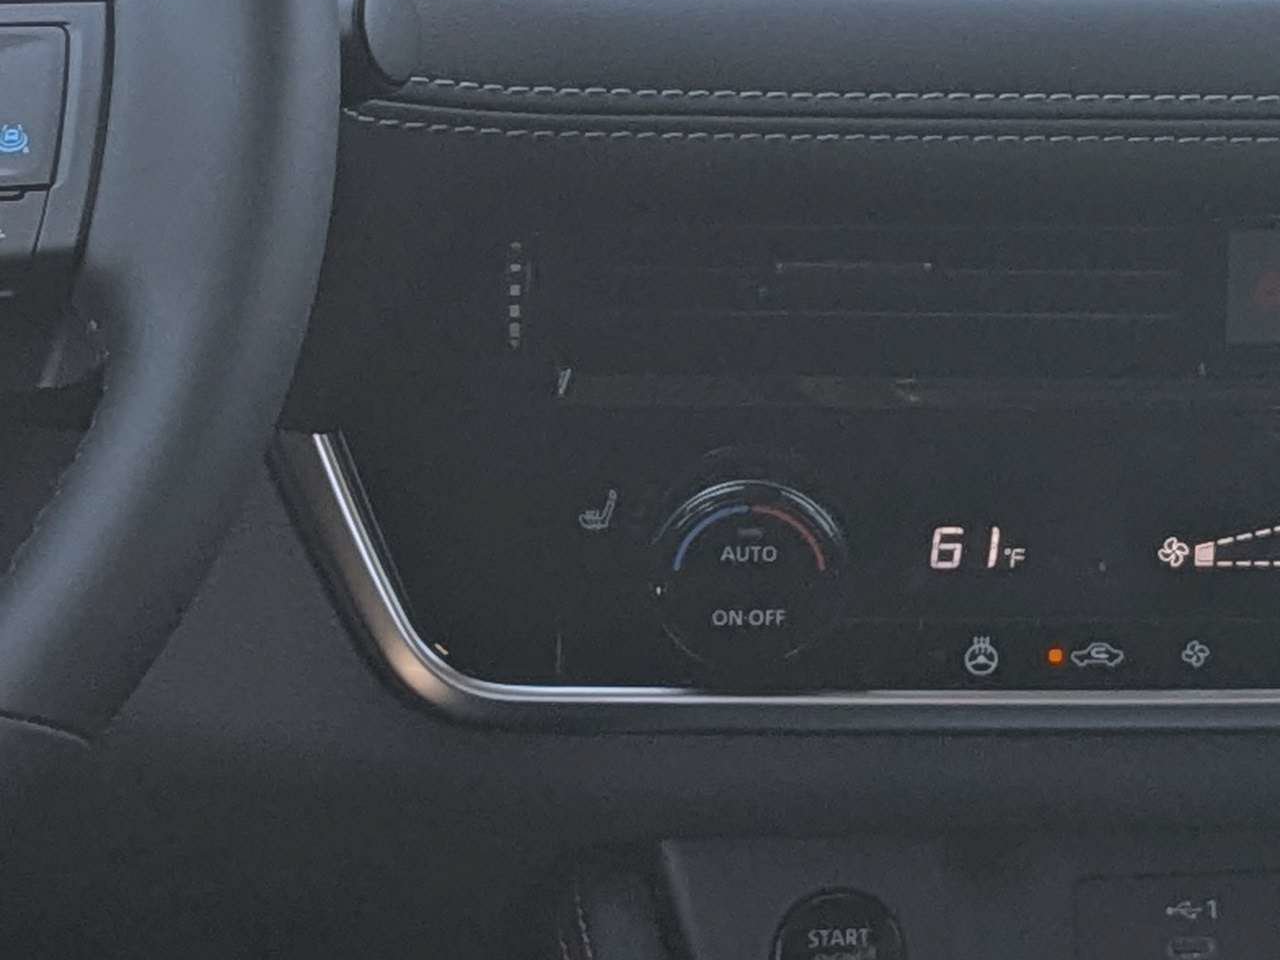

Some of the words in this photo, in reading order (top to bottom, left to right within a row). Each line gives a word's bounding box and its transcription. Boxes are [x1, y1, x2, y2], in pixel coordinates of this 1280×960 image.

[720, 546, 778, 562] AUTO
[1206, 899, 1218, 919] 1
[807, 927, 872, 948] START
